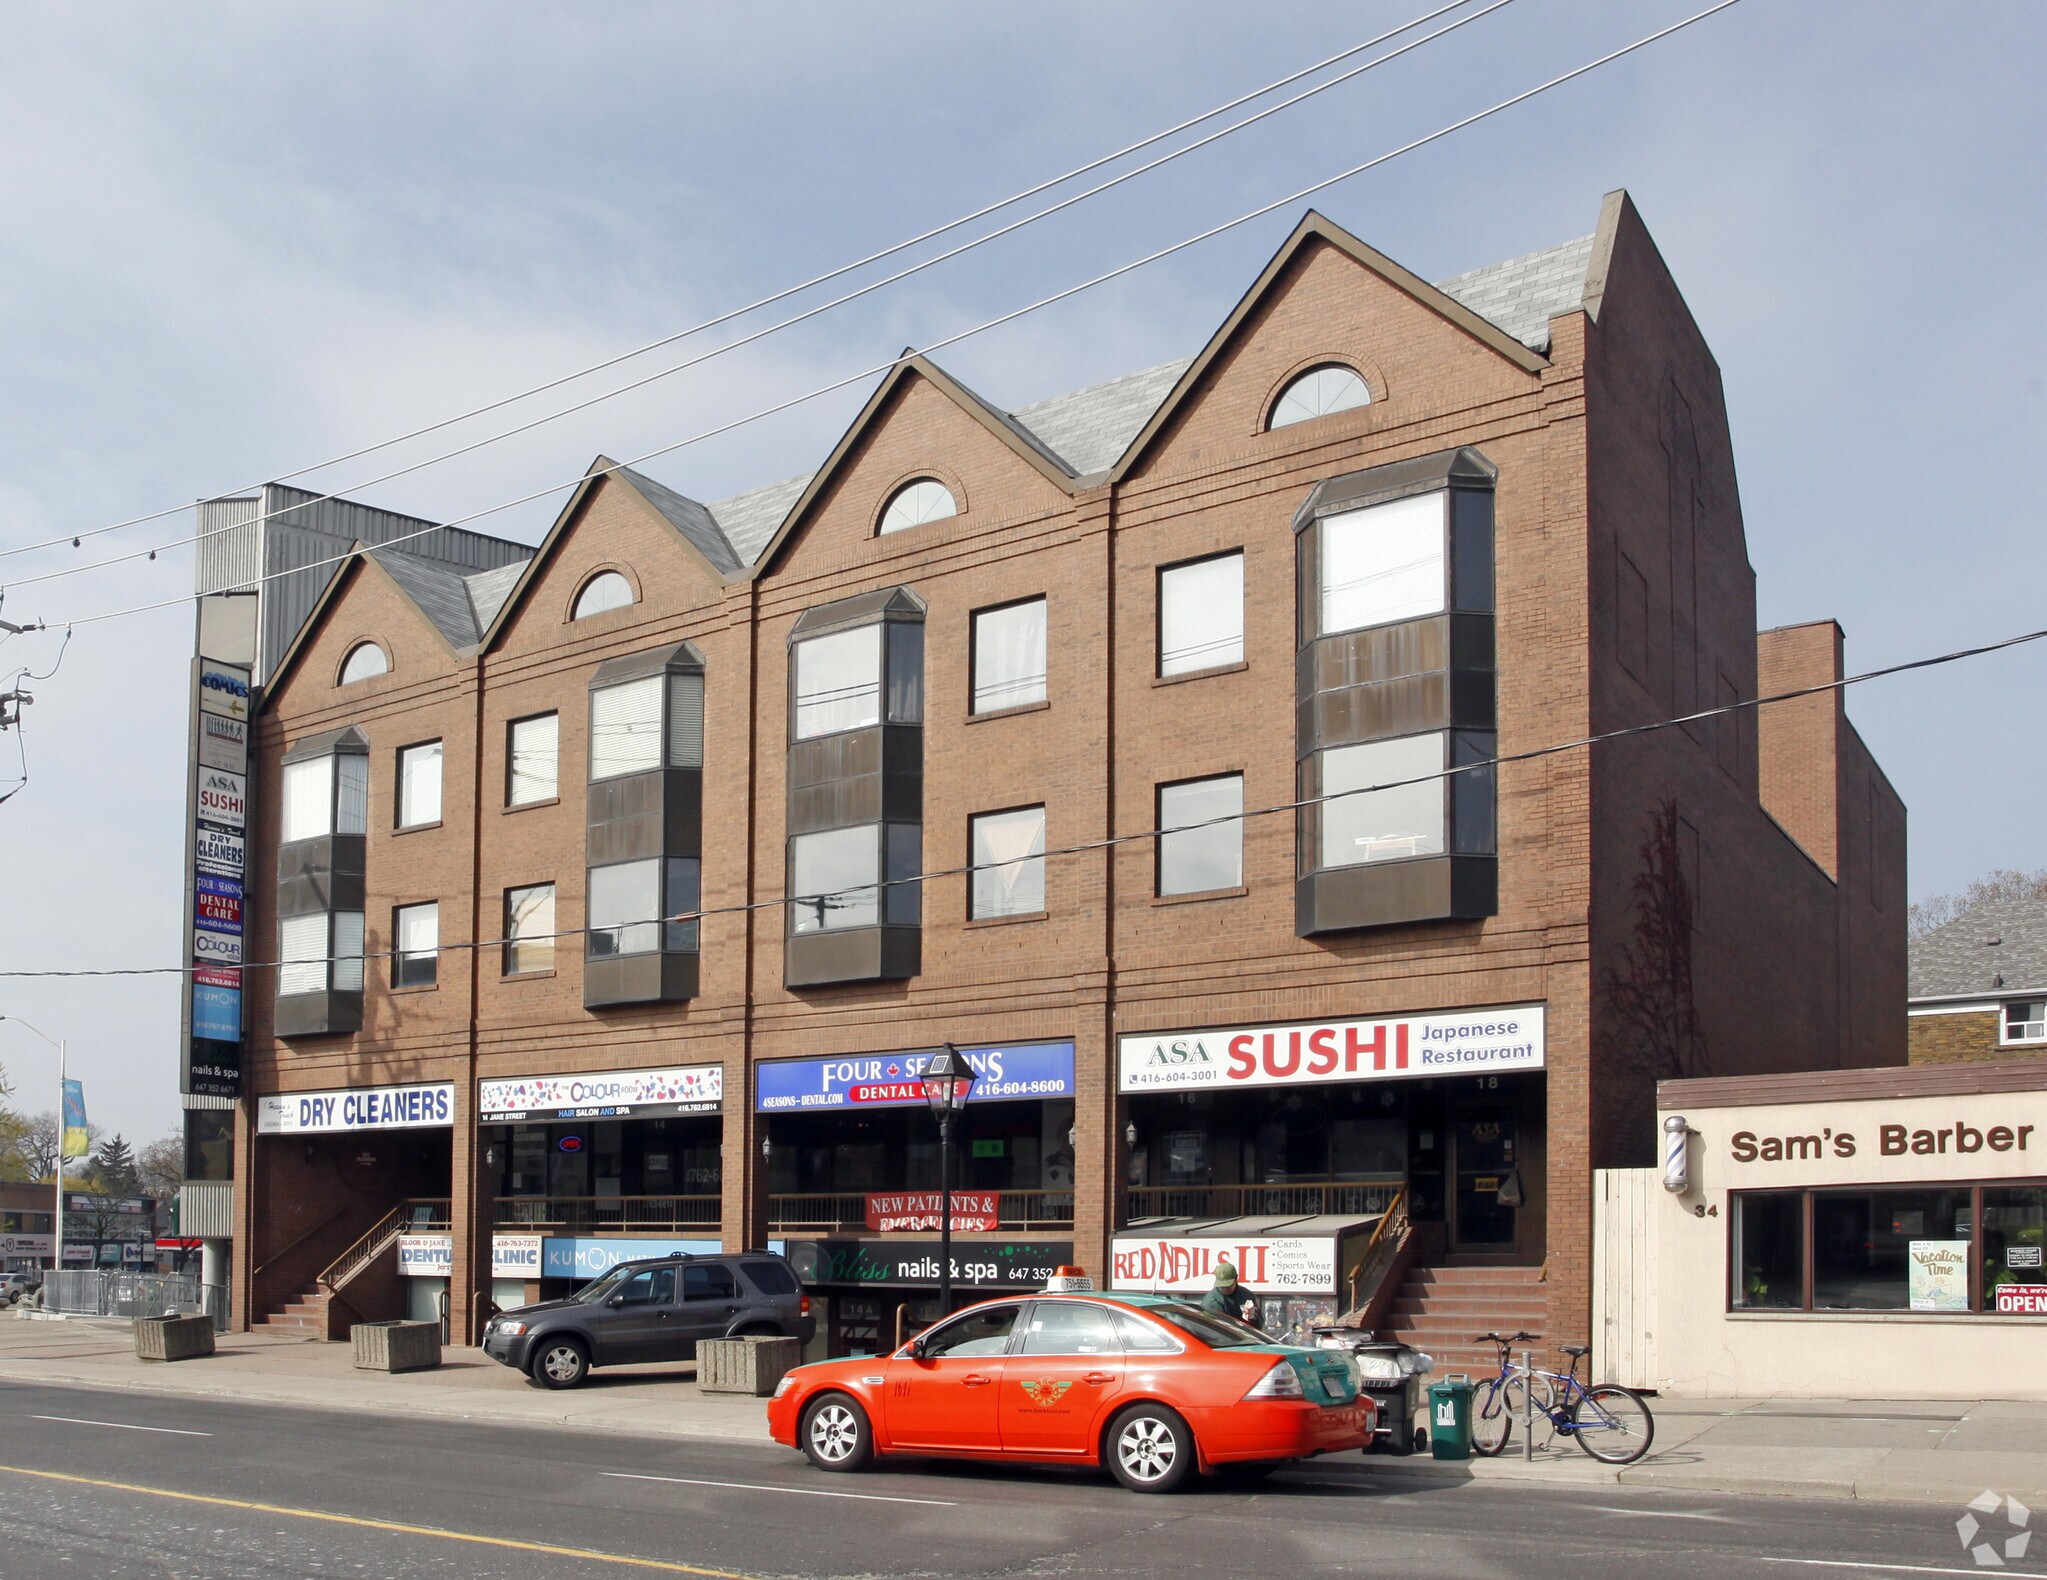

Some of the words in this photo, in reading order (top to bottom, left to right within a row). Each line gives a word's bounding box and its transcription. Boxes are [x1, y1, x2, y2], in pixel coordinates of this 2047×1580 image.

[201, 672, 249, 698] COMICS
[206, 775, 239, 794] ASA
[200, 790, 243, 814] SUSHI
[210, 833, 231, 844] DRY
[197, 839, 243, 864] CLEANERS
[196, 878, 214, 891] FOUR
[218, 881, 243, 899] SEASONS
[200, 893, 240, 911] DENTAL
[206, 906, 233, 921] CARE
[196, 936, 240, 956] COLOUR
[195, 992, 238, 1005] KUMON
[1145, 1038, 1213, 1067] ASA
[1226, 1023, 1409, 1080] SUSHI
[1420, 1020, 1520, 1044] Japanese
[1140, 1070, 1218, 1084] 416-604-3001
[1420, 1041, 1535, 1066] Restaurant
[191, 1065, 213, 1076] nails
[213, 1066, 222, 1076] &
[223, 1069, 239, 1080] spa
[822, 1061, 882, 1093] FOUR
[975, 1079, 1065, 1096] 416-604-8600
[1477, 1077, 1498, 1089] 18
[570, 1082, 620, 1102] COLOUR
[859, 1085, 915, 1099] DENTAL
[1178, 1092, 1196, 1104] 16
[299, 1097, 336, 1127] DRY
[343, 1088, 448, 1124] CLEANERS
[558, 1109, 575, 1118] HAIR
[576, 1107, 599, 1117] SALON
[600, 1107, 615, 1116] AND
[616, 1106, 630, 1115] SPA
[489, 1113, 504, 1121] JANE
[505, 1112, 527, 1120] STREET
[1731, 1127, 1856, 1163] Sam's
[1880, 1121, 2034, 1156] Barber
[871, 1198, 903, 1214] NEW
[907, 1195, 978, 1213] PATINTS
[981, 1196, 994, 1213] &
[1695, 1204, 1718, 1218] 34
[401, 1239, 422, 1247] BLOOR
[429, 1239, 446, 1248] JANE
[1276, 1240, 1303, 1249] Cards
[550, 1247, 620, 1270] KUMON
[1114, 1247, 1156, 1280] RED
[1158, 1241, 1231, 1284] NAILS
[1234, 1245, 1270, 1284] II
[1276, 1250, 1308, 1260] Comics
[1912, 1249, 1964, 1264] Vacation
[810, 1248, 891, 1281] Bliss
[898, 1256, 940, 1279] nails
[949, 1258, 959, 1278] &
[964, 1262, 998, 1284] spa
[1008, 1267, 1029, 1280] 647
[1032, 1267, 1053, 1280] 352
[1276, 1261, 1305, 1272] Sports
[1307, 1262, 1331, 1271] Wear
[1923, 1262, 1954, 1276] Time
[1065, 1278, 1092, 1290] 751-5555
[1276, 1273, 1332, 1285] 762-7899
[2000, 1296, 2047, 1312] OPEN
